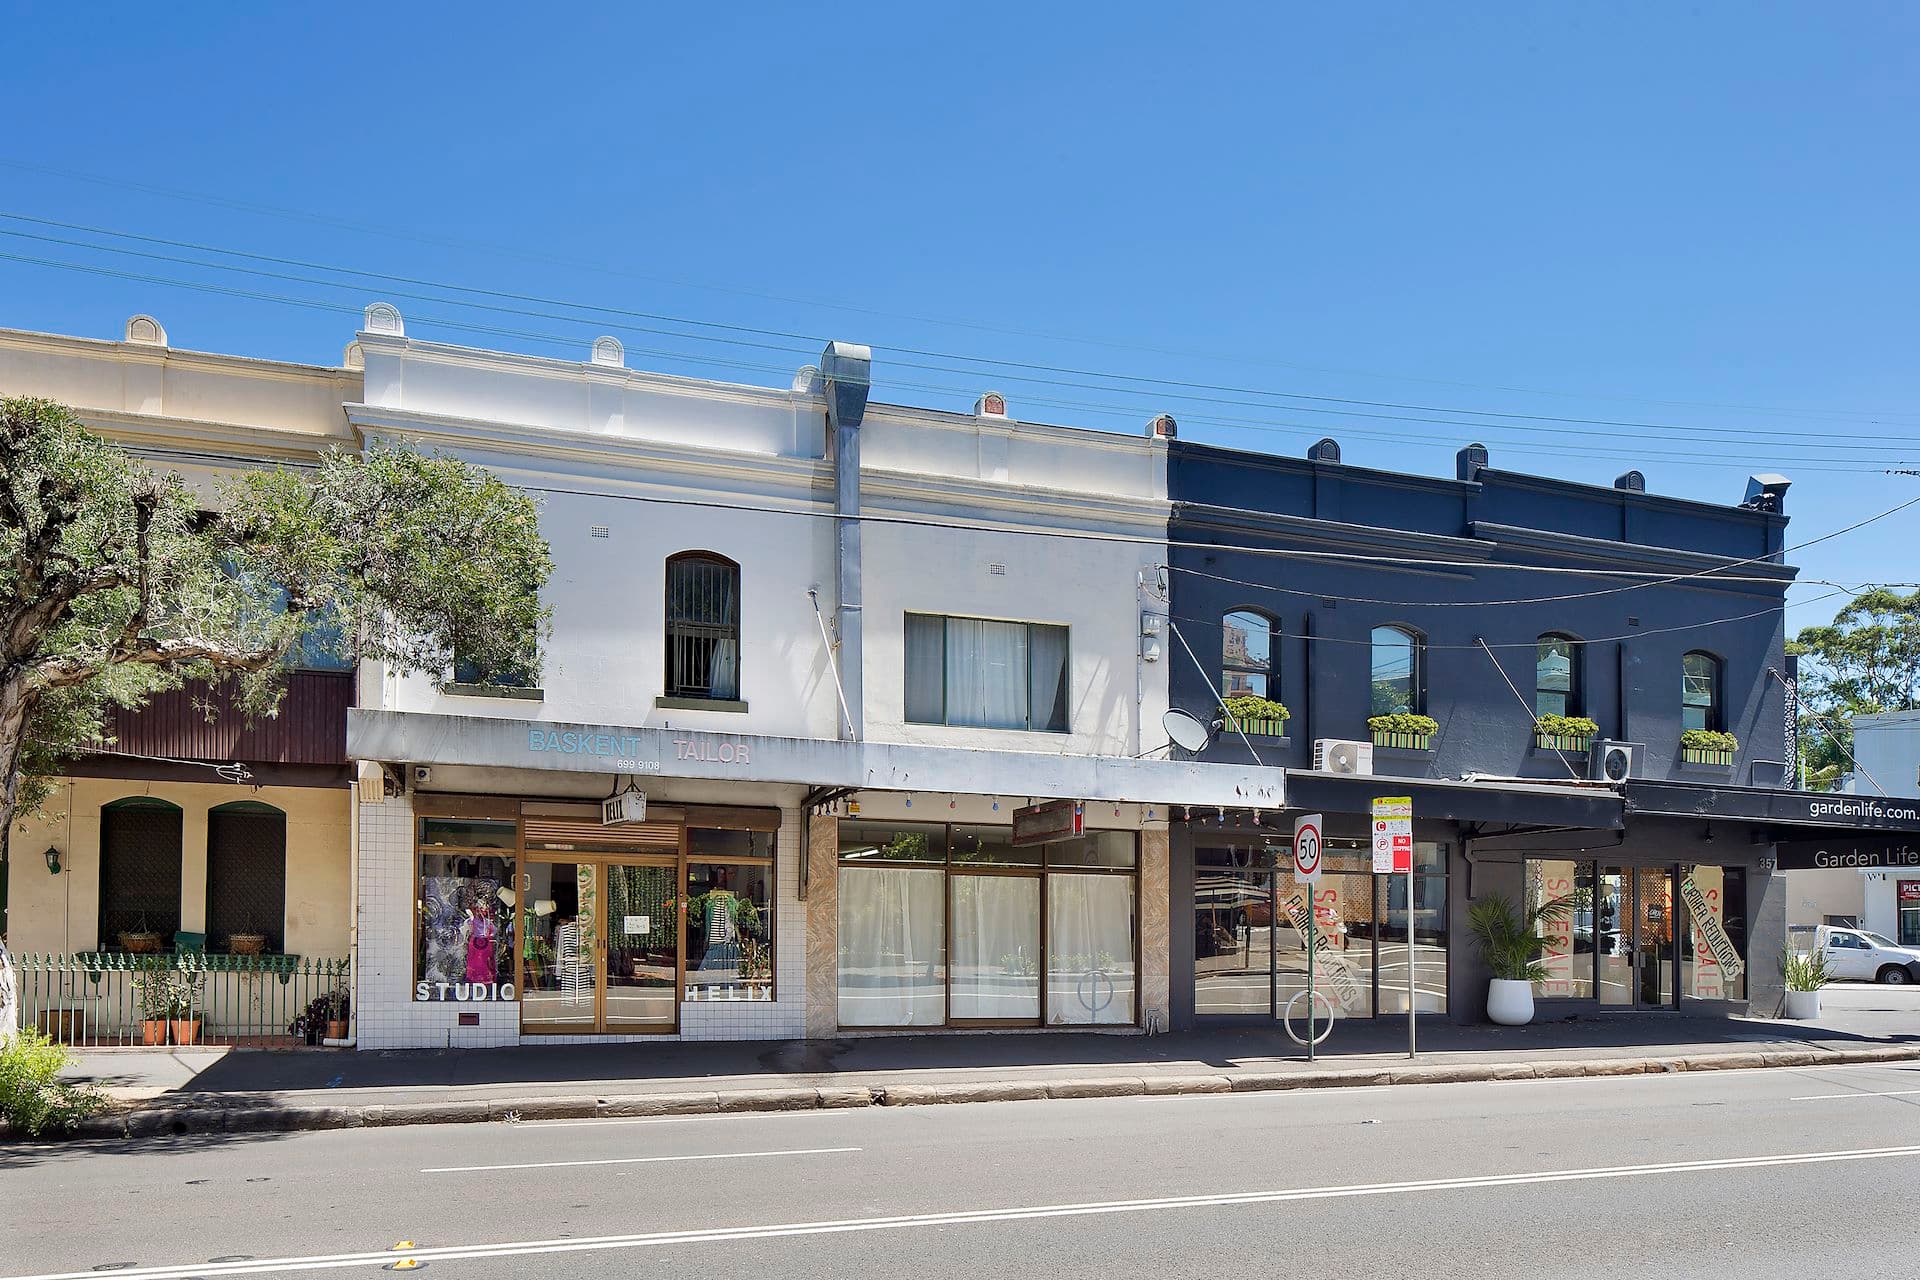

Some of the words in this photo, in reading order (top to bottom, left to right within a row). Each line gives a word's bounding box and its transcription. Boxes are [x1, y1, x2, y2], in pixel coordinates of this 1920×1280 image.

[529, 730, 641, 757] BASKENT
[673, 739, 750, 765] TAILOR
[617, 760, 635, 769] 699
[638, 761, 660, 770] 9108
[1300, 838, 1317, 860] 50
[1815, 849, 1880, 868] Garden
[1886, 846, 1919, 866] Life
[416, 982, 516, 1001] STUDIO
[685, 985, 773, 1001] HELIX
